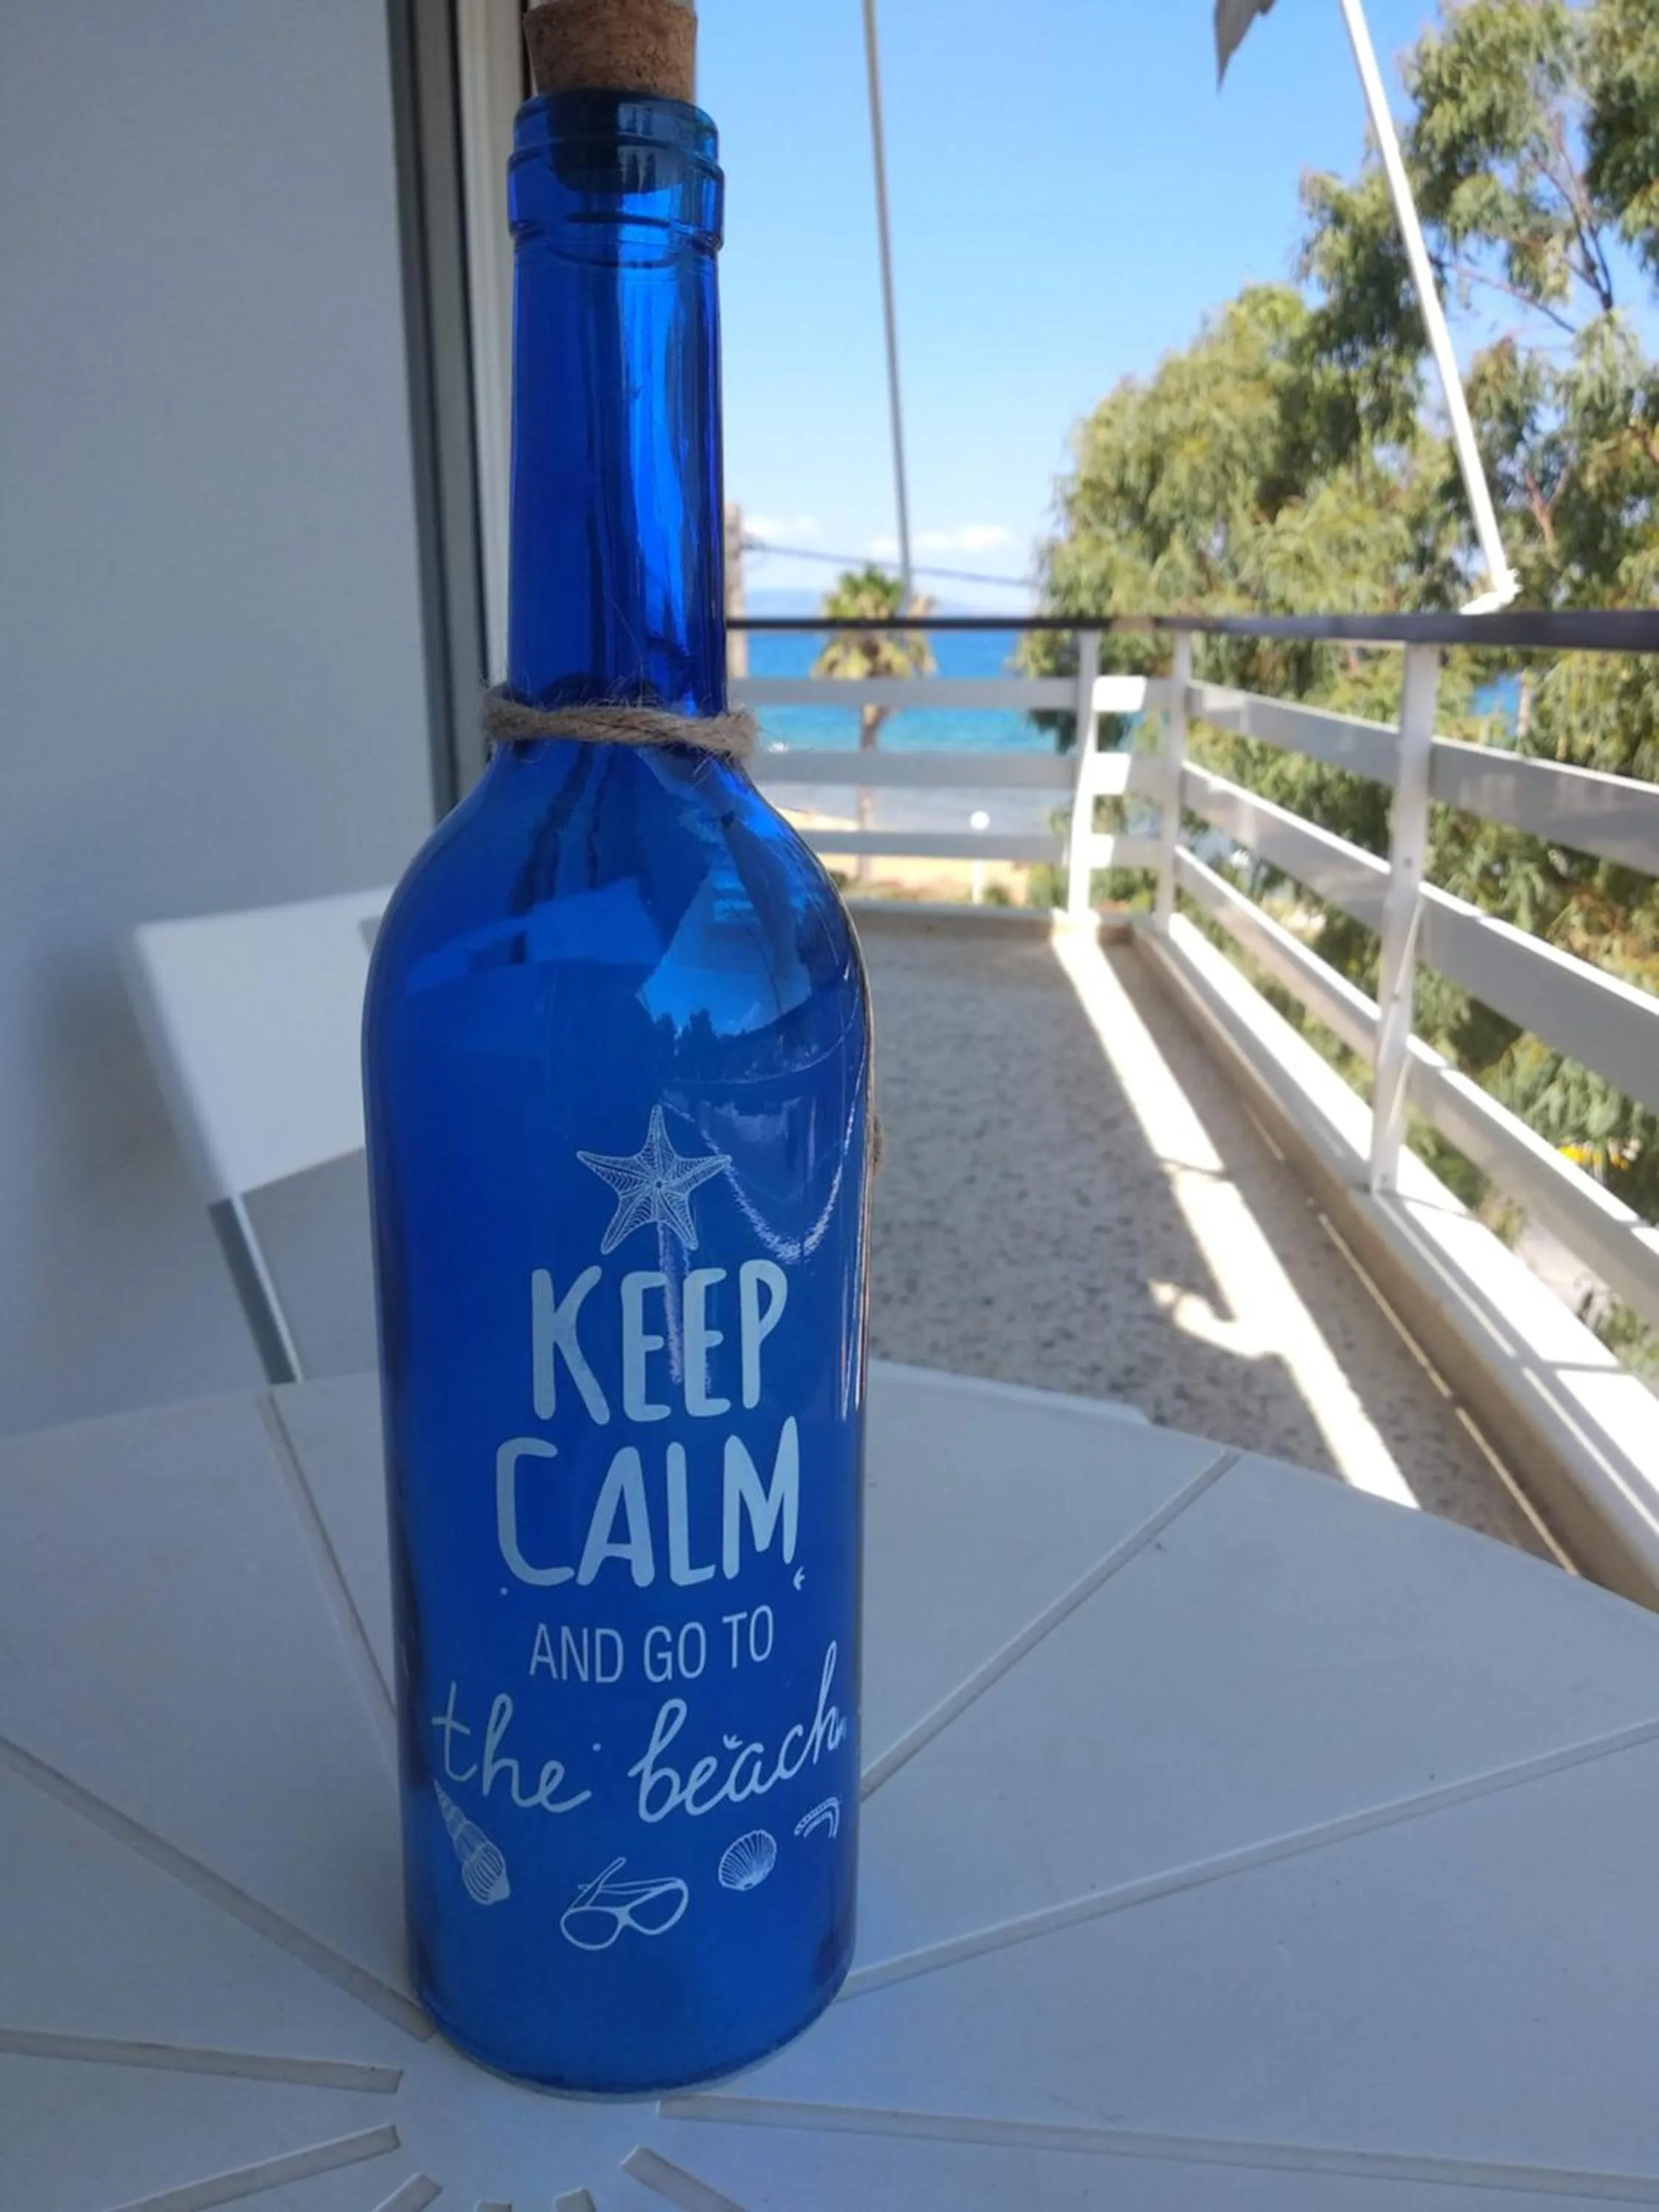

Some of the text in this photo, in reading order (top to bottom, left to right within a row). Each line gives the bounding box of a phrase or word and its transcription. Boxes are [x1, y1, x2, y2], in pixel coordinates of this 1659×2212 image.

[531, 1259, 788, 1425] KEEP
[495, 1415, 800, 1587] CALM
[529, 1604, 774, 1683] AND GO TO
[431, 1639, 845, 1823] the beach
